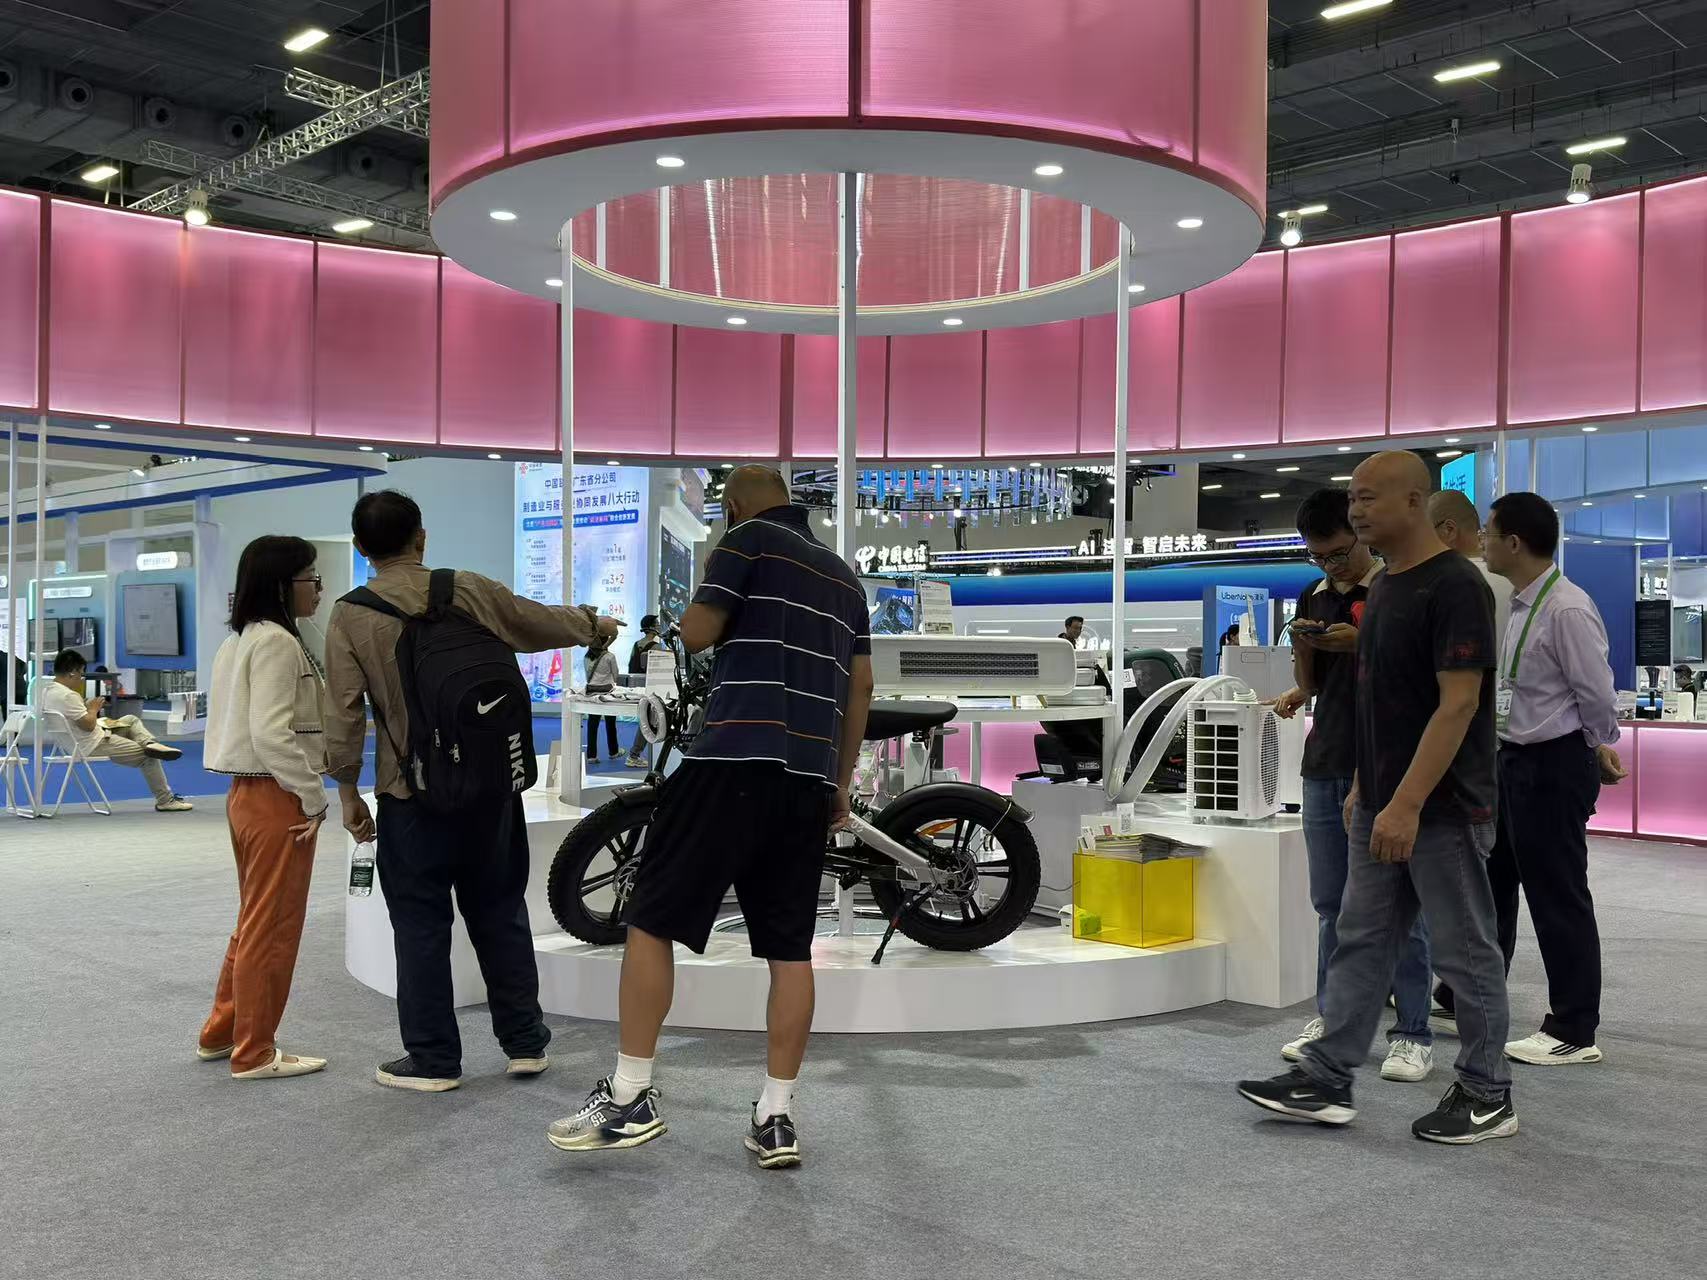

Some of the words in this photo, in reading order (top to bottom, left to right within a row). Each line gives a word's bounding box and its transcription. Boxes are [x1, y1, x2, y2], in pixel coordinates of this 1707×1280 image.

[878, 544, 926, 566] 中国电信
[1077, 540, 1095, 556] AI
[1143, 533, 1206, 554] 智启未来
[508, 732, 526, 793] NIKE
